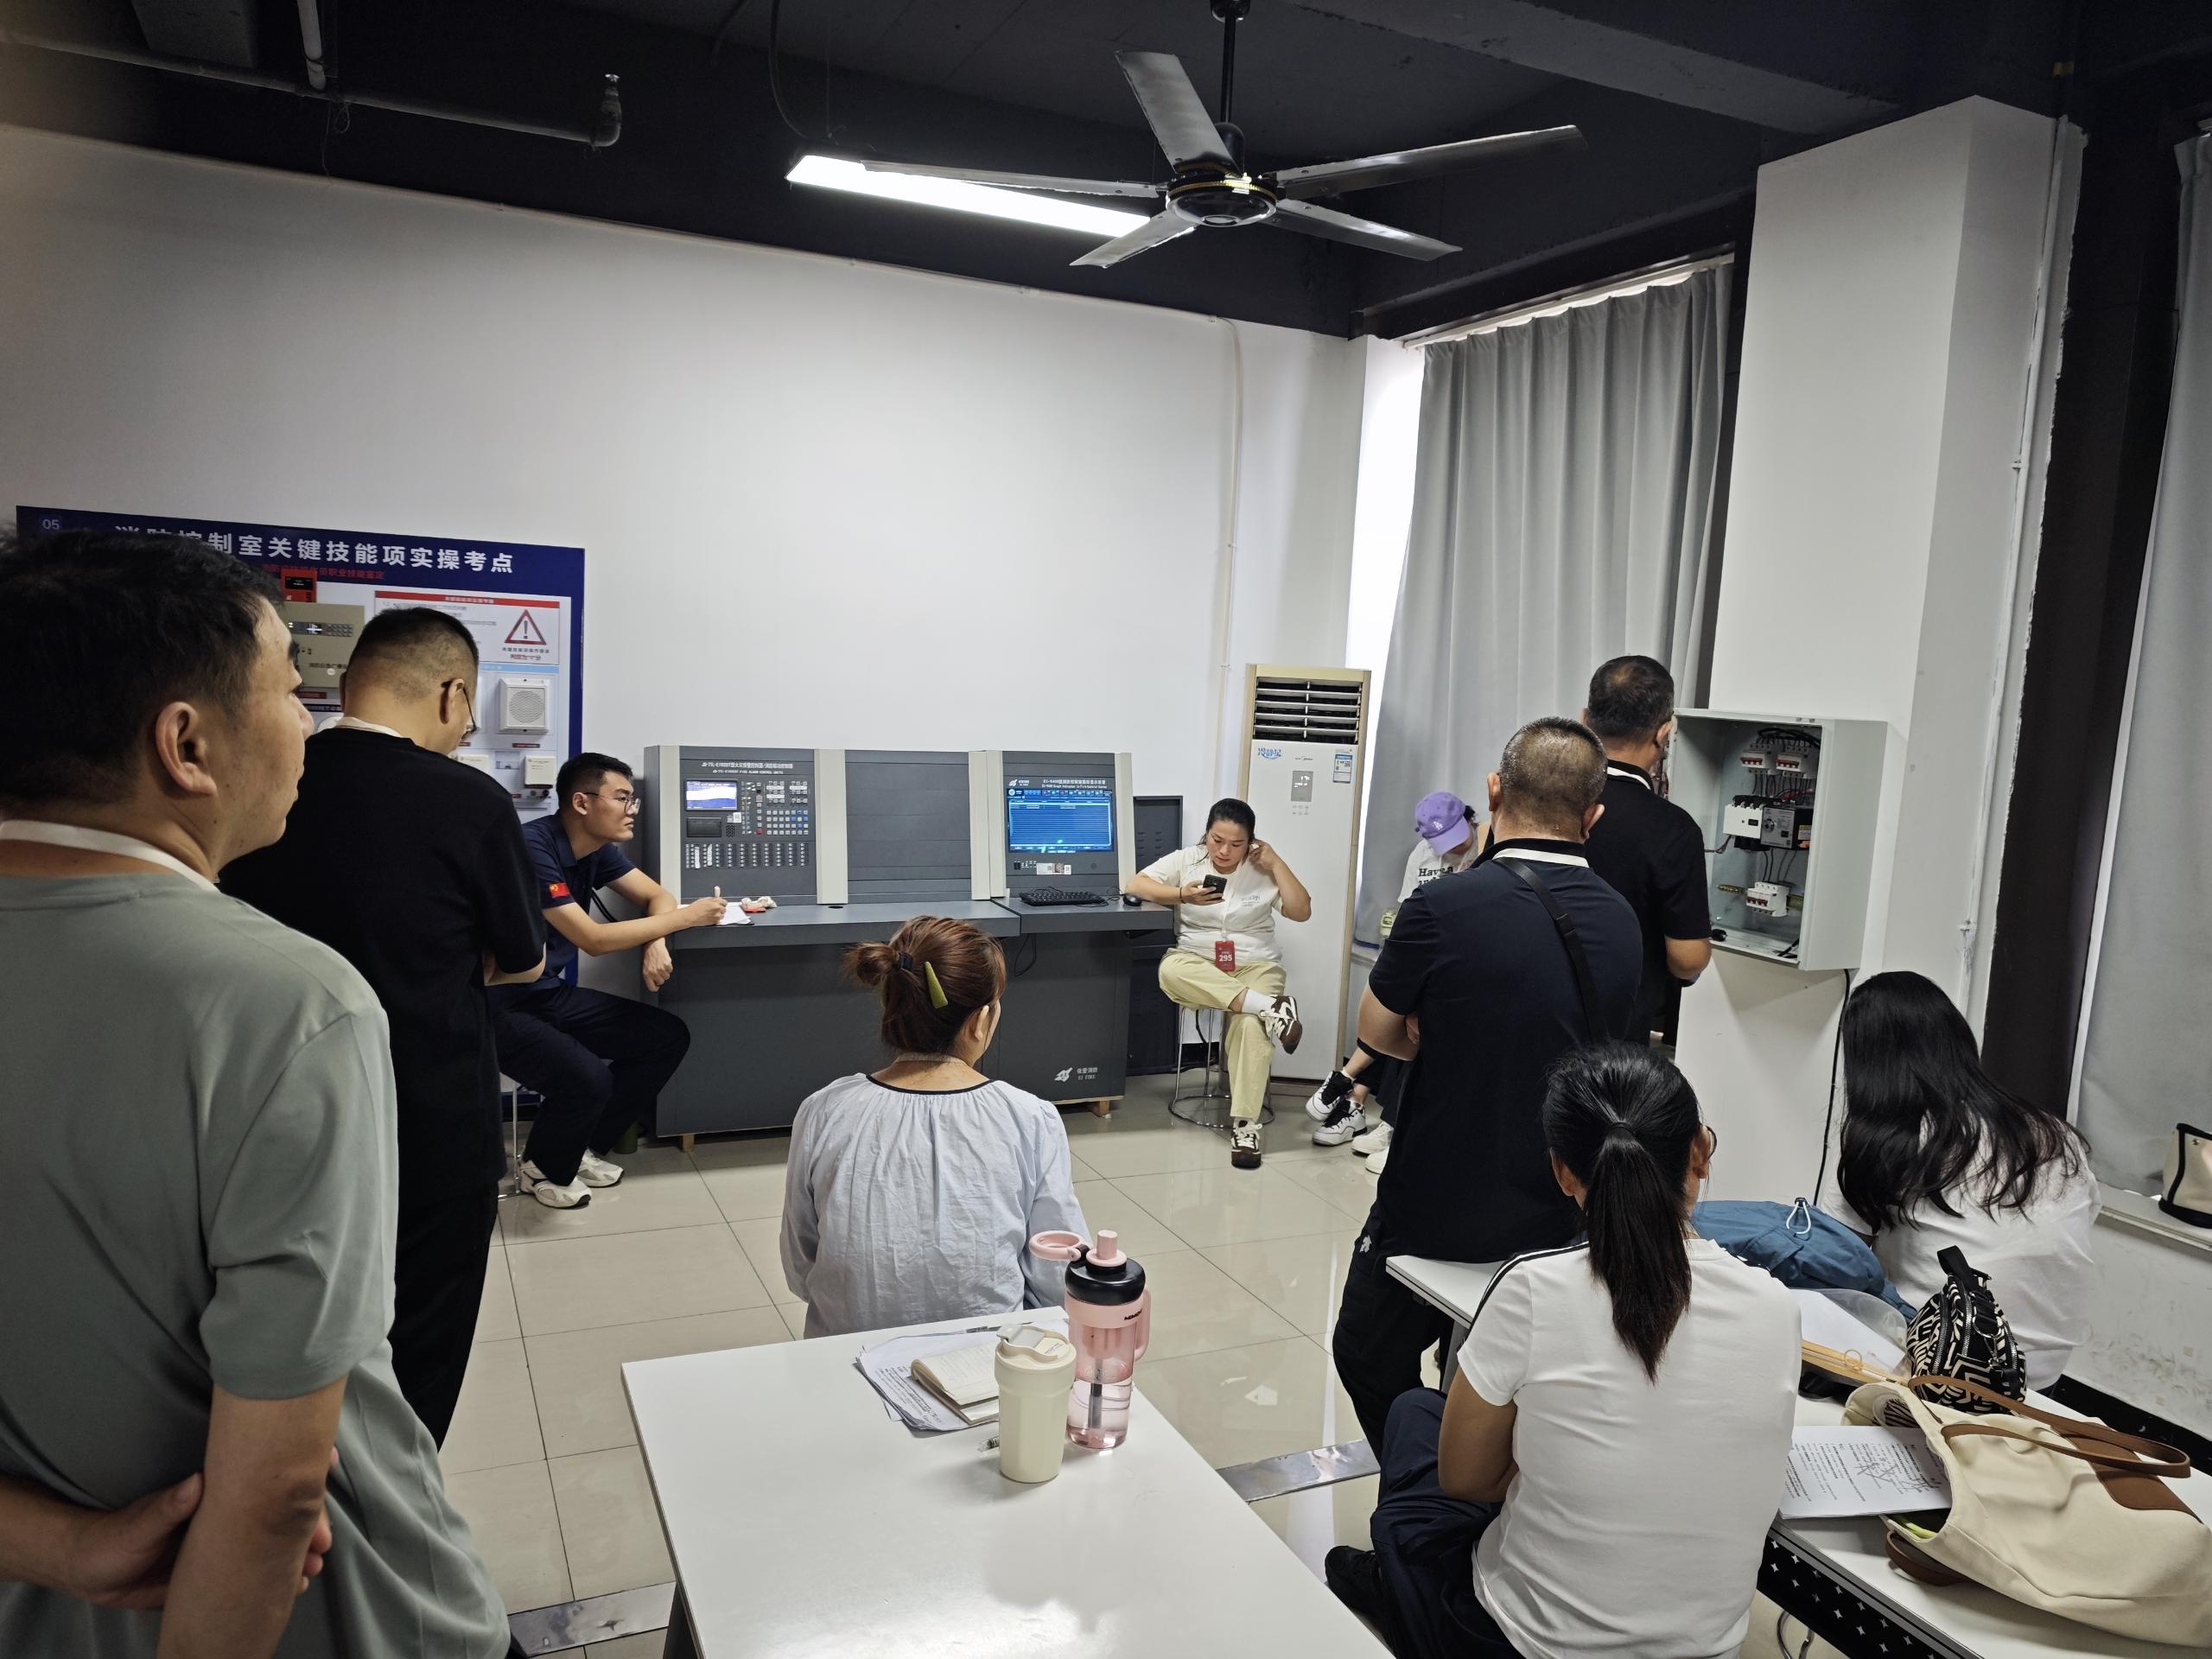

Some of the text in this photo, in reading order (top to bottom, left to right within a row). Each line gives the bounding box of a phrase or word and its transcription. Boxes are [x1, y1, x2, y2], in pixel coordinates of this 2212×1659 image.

[43, 518, 60, 531] 05
[115, 525, 513, 575] 制室关键技能项实操考点
